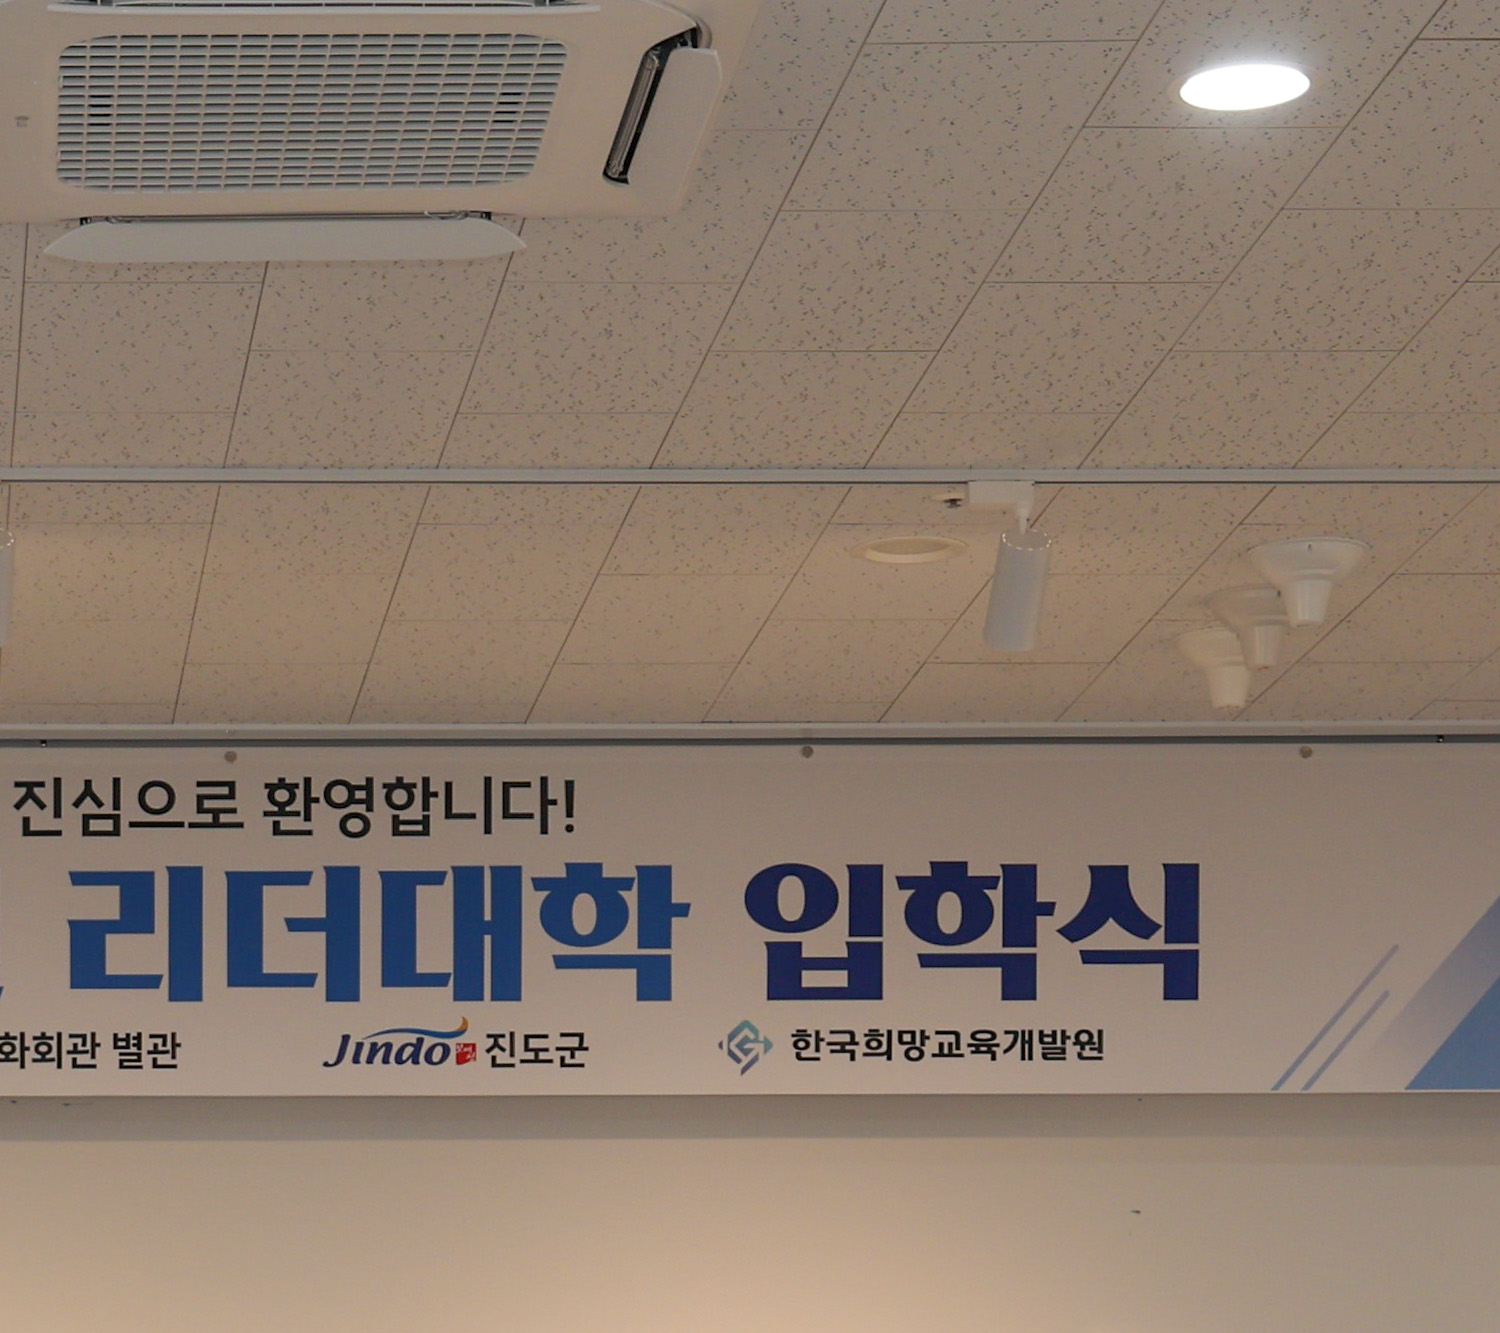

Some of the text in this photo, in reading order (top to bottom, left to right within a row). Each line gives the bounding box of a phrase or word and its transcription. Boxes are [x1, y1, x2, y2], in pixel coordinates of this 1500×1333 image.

[12, 776, 245, 838] 진심으로
[262, 775, 576, 839] 환영합니다!
[66, 862, 691, 1002] 리더대학
[742, 861, 1203, 1001] 입학식
[111, 1031, 182, 1070] 별관
[322, 1033, 452, 1068] Jindo
[485, 1031, 590, 1069] 진도군
[789, 1028, 1105, 1063] 한국희망교육개발원
